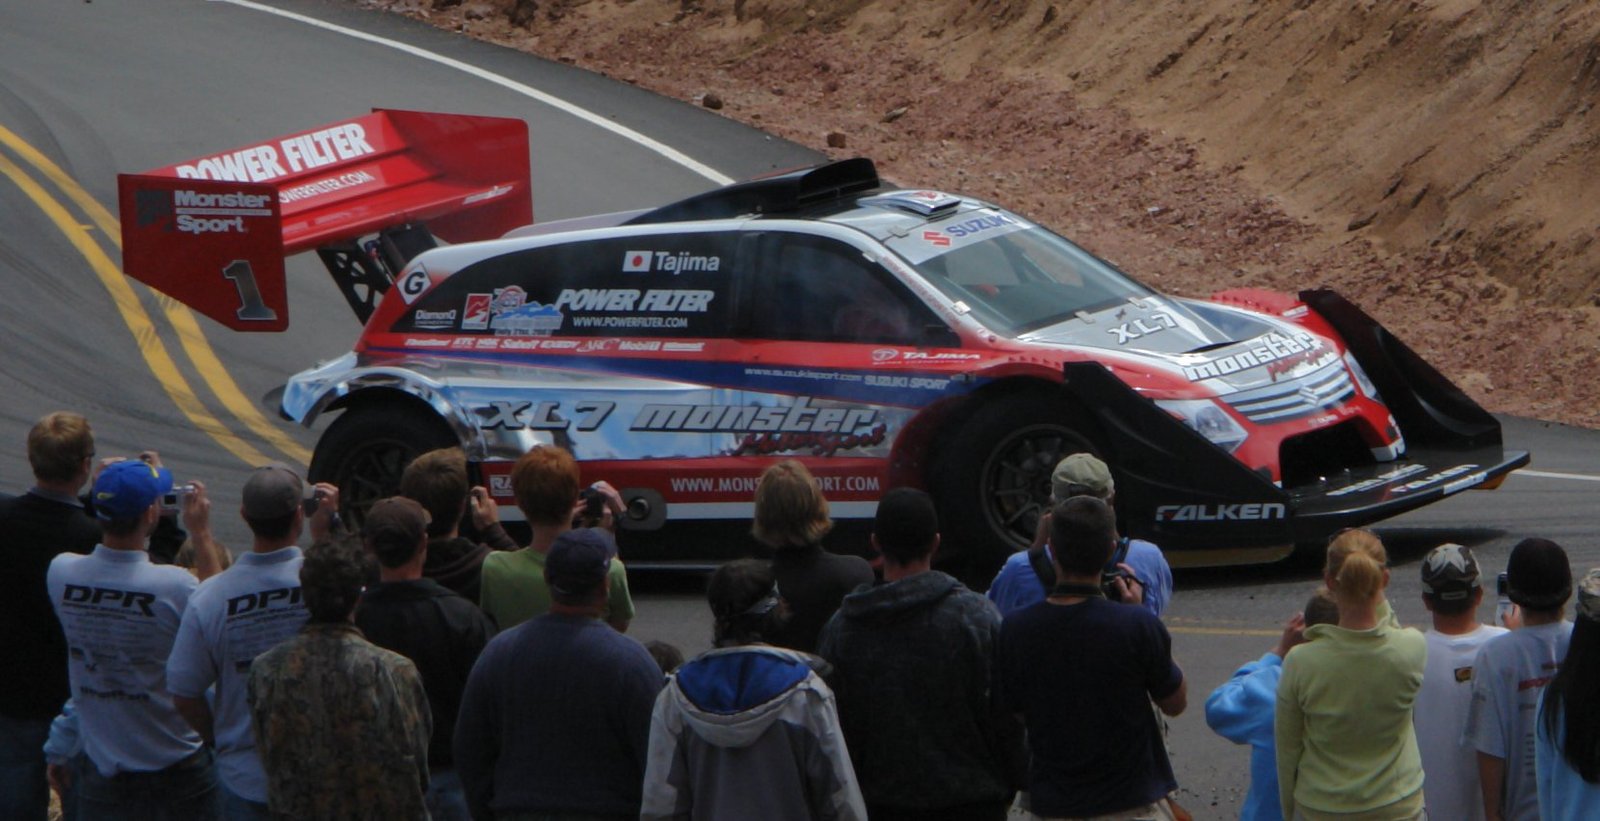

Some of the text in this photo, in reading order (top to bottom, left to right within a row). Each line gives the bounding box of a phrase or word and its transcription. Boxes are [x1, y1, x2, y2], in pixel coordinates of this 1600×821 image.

[279, 122, 377, 173] FILTER
[174, 190, 271, 207] Monster
[176, 215, 244, 234] Sport
[655, 250, 721, 275] Tajima
[221, 258, 278, 321] 1
[404, 270, 426, 297] G
[555, 288, 716, 313] POWER FILTER
[572, 315, 689, 329] WWW.POWERFILTER.COM
[1107, 311, 1179, 347] XL7
[903, 351, 981, 361] TAJIMA
[1182, 329, 1316, 382] monster
[864, 373, 909, 387] SUZUKI
[908, 376, 951, 391] SPORT
[479, 394, 881, 436] XL7 monster
[670, 476, 881, 494] WWW.MONSORT.COM
[1154, 502, 1286, 522] FALKEN
[61, 584, 156, 618] DPR
